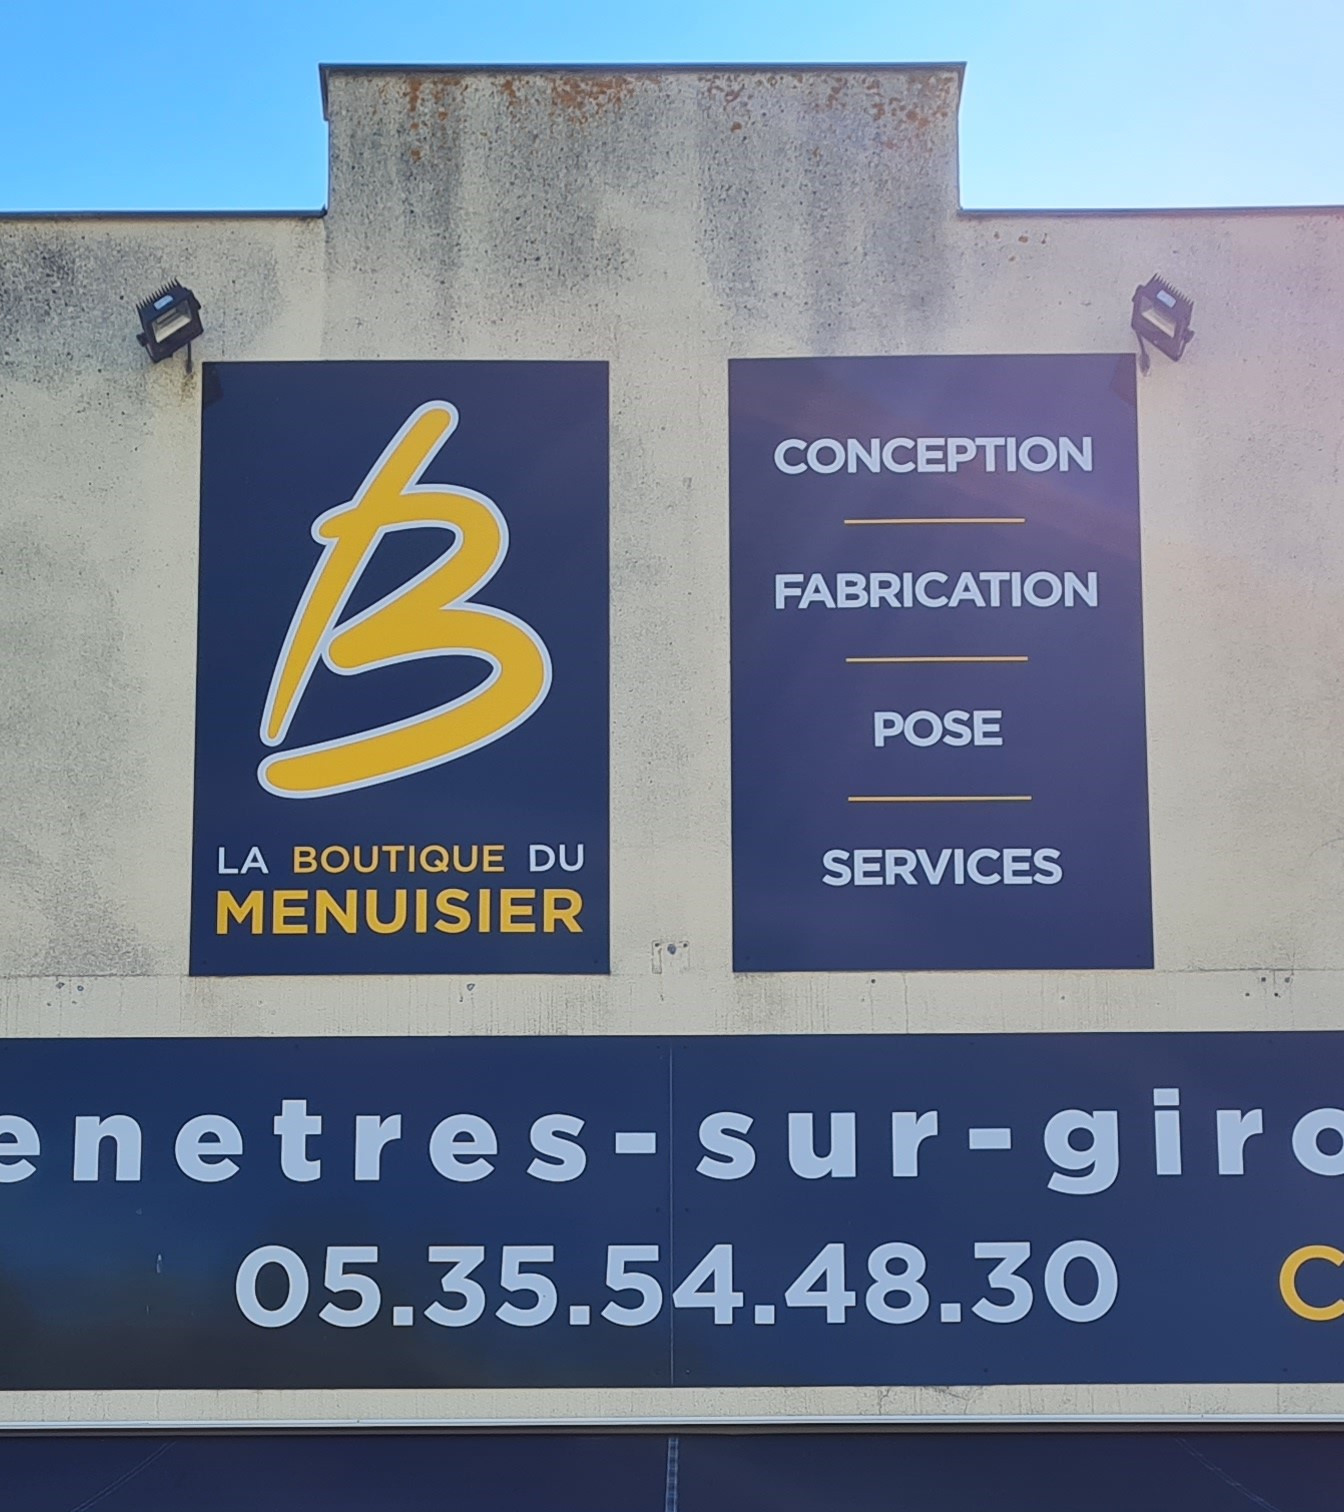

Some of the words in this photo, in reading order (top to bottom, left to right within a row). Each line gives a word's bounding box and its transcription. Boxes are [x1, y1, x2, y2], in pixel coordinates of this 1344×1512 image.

[772, 436, 1092, 476] CONCEPTION
[776, 572, 1097, 609] FABRICATION
[875, 711, 1002, 746] POSE
[219, 847, 268, 873] LA
[294, 845, 504, 873] BOUTIQUE
[530, 844, 583, 871] DU
[823, 848, 1062, 885] SERVICES
[216, 889, 583, 935] MENUISIER
[236, 1240, 1117, 1327] 05.35.54.48.30
